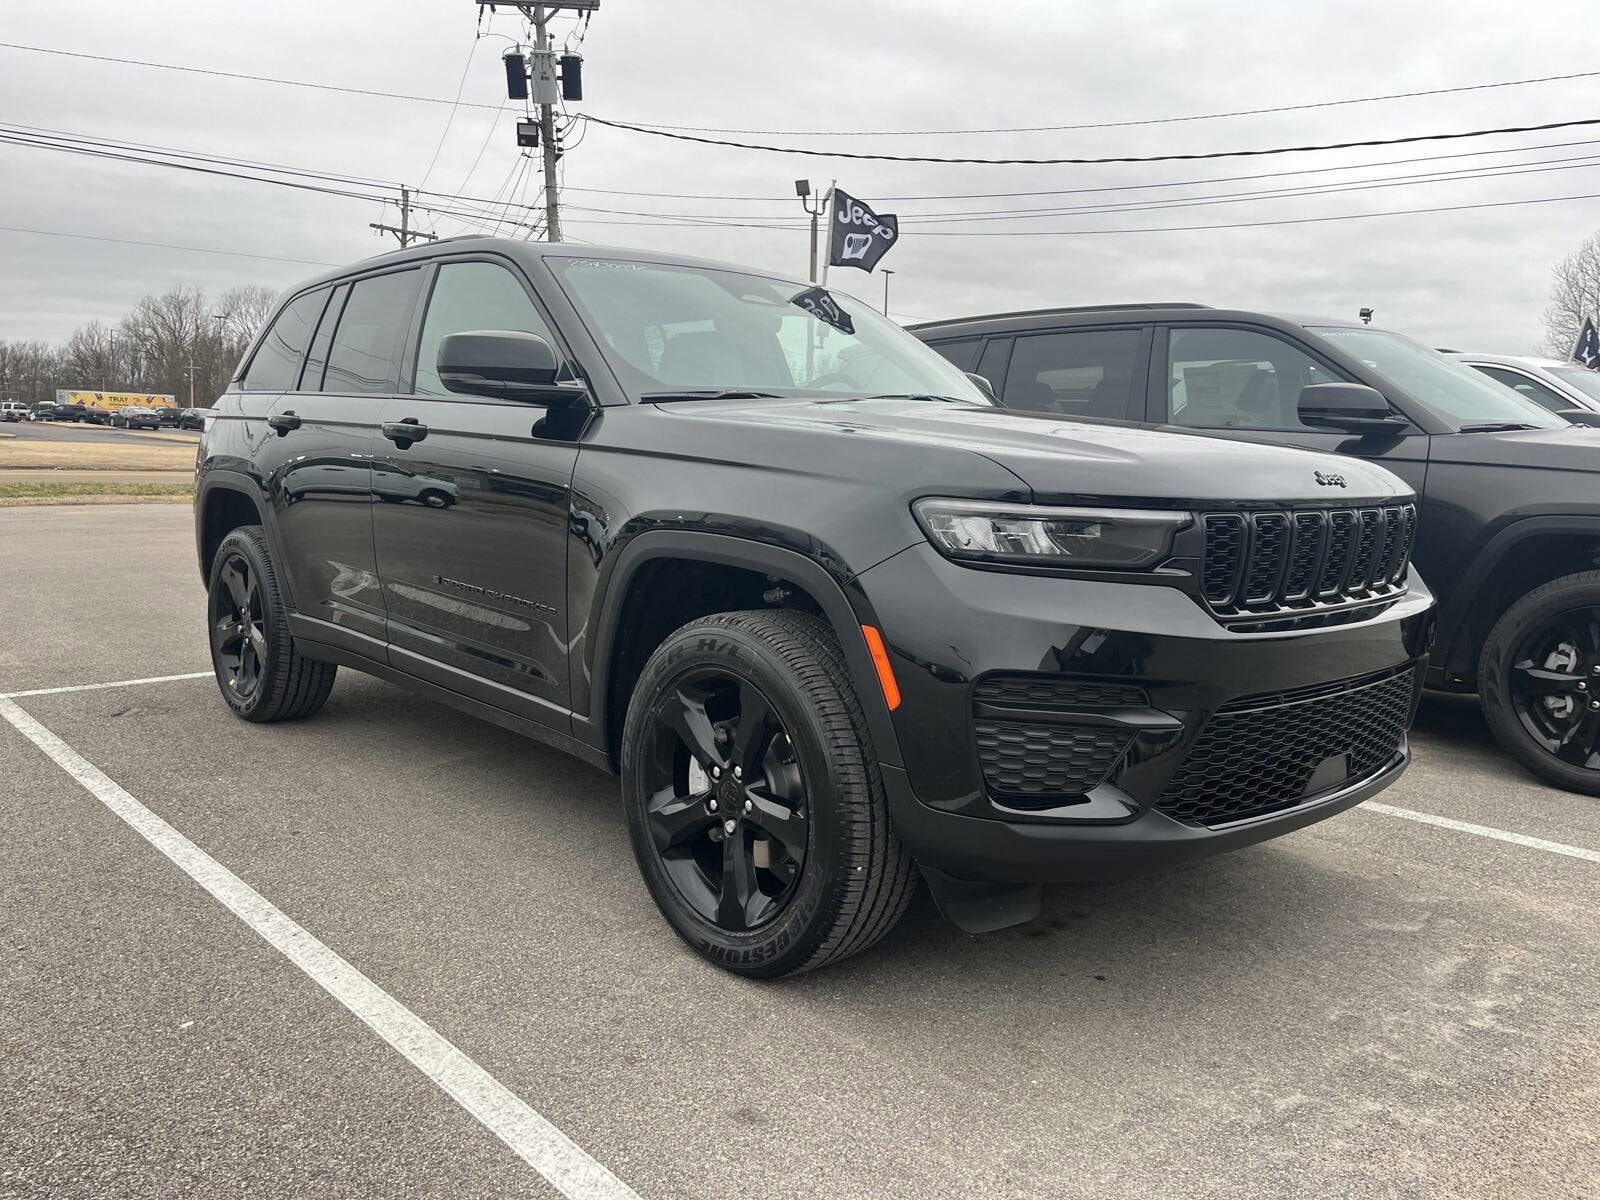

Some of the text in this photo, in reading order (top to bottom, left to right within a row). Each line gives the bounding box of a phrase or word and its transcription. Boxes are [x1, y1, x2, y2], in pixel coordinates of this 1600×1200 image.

[838, 198, 894, 240] Jeep
[1313, 470, 1348, 489] Jeep
[697, 638, 746, 662] H/L
